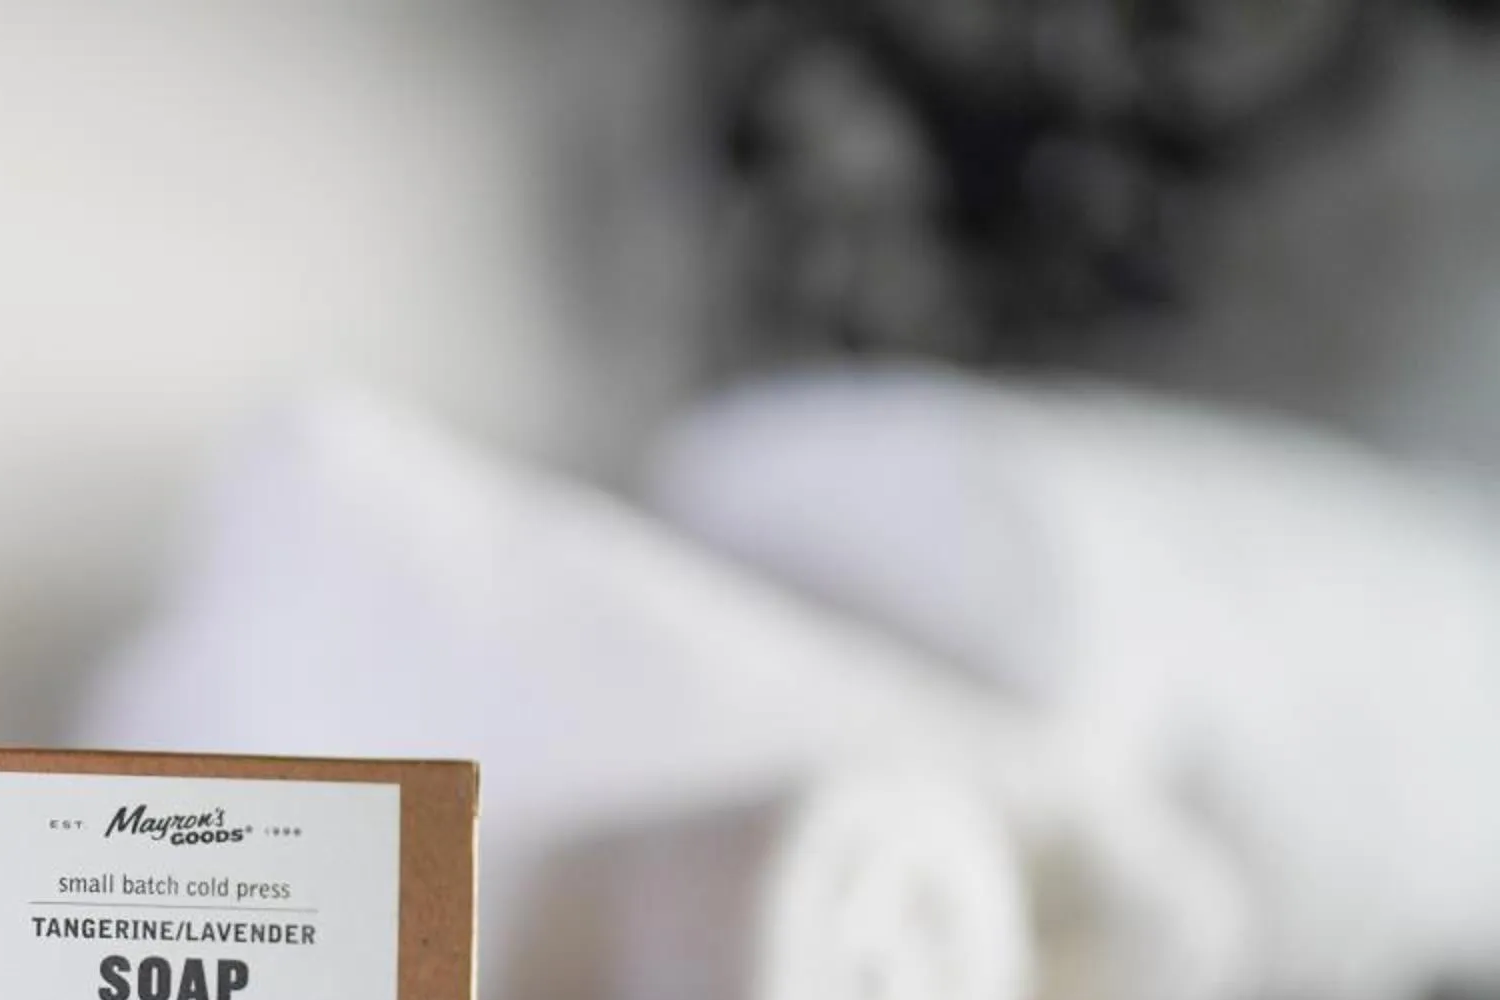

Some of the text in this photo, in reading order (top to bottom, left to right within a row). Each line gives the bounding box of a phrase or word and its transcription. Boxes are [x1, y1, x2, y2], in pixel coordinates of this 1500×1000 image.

[104, 804, 225, 841] Mayron's
[58, 873, 290, 901] small batch cold press
[31, 916, 316, 945] TANGERINE/LAVENDER
